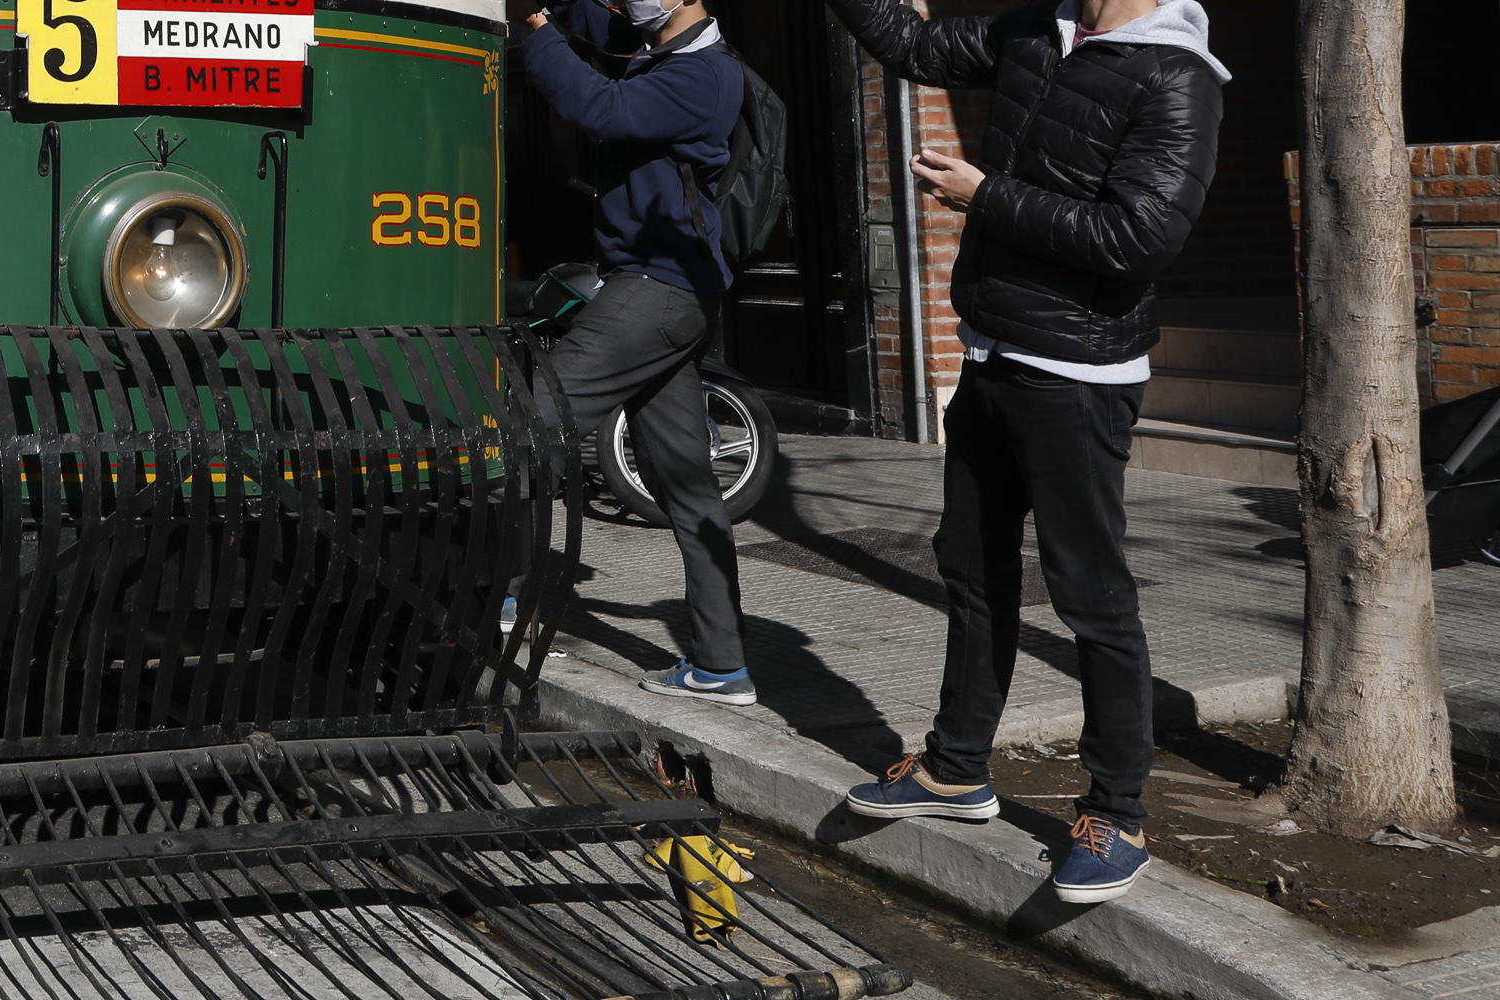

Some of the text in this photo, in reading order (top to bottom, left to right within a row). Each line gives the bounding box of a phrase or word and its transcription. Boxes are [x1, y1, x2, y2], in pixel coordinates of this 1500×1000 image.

[143, 19, 281, 49] MEDRANO
[144, 65, 281, 93] B. MITRE
[370, 190, 481, 249] 258
